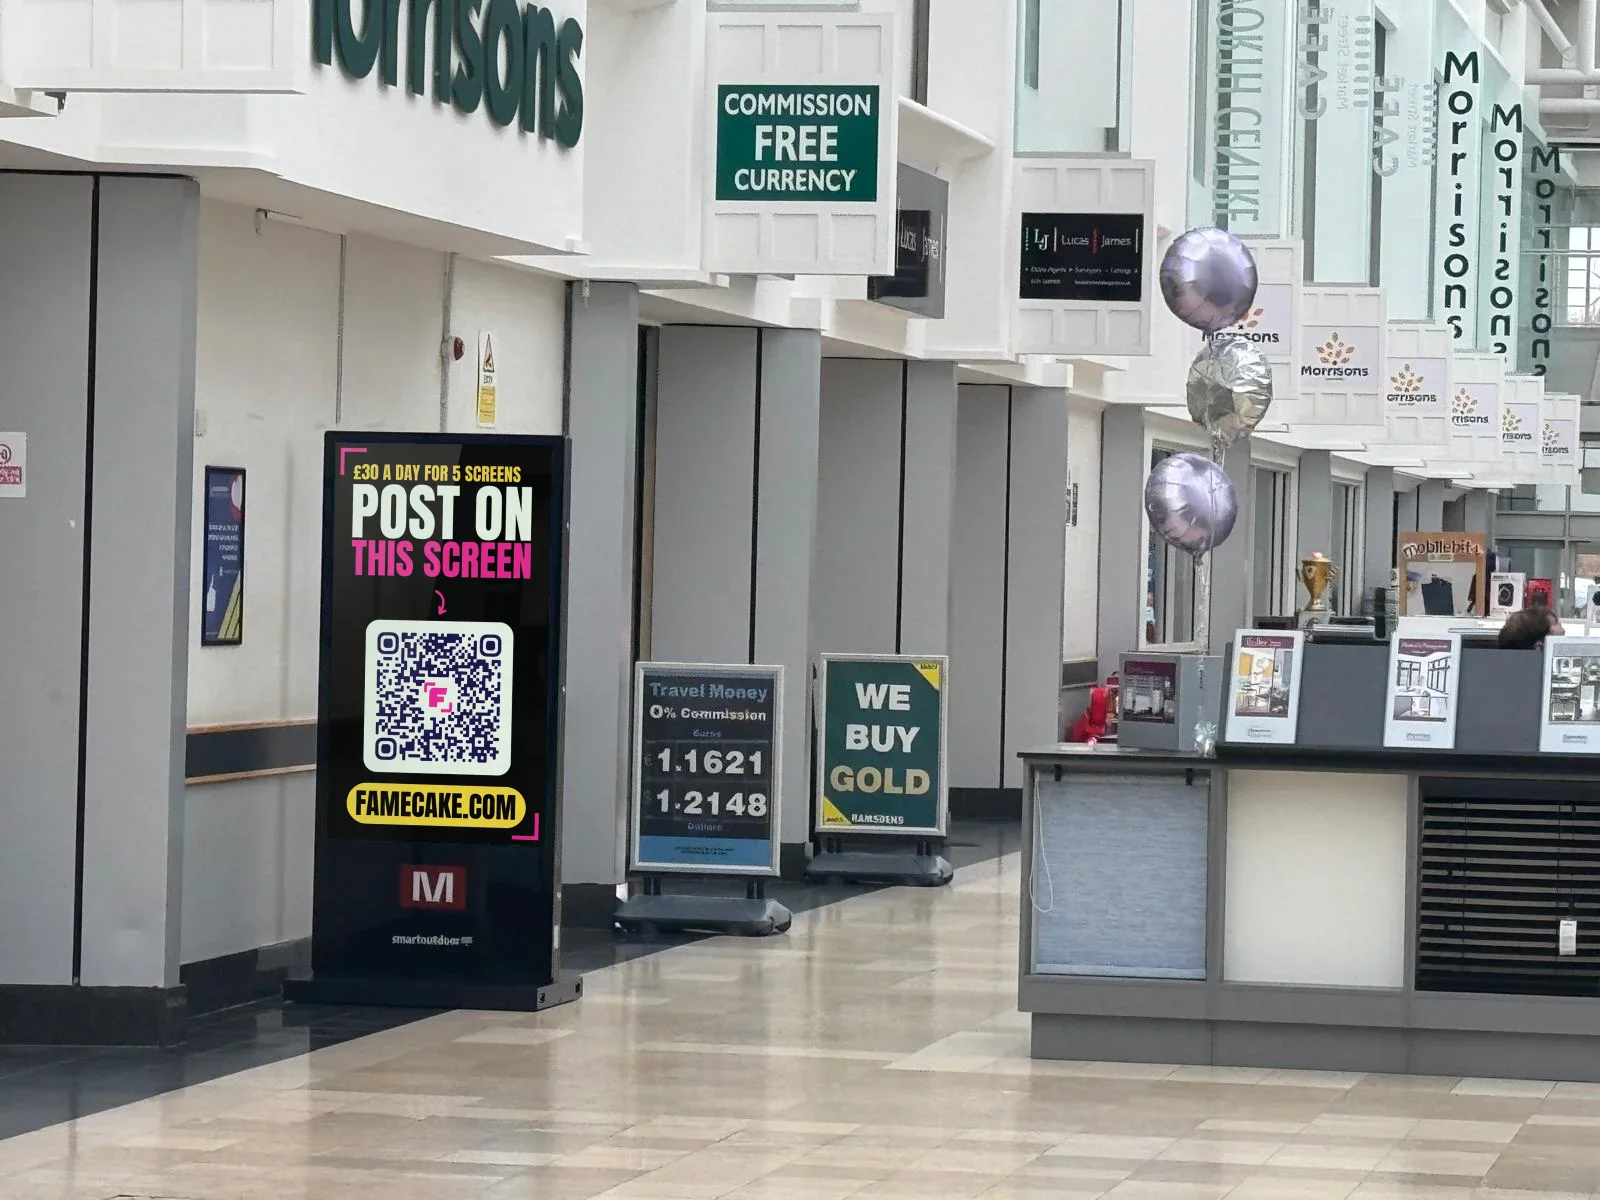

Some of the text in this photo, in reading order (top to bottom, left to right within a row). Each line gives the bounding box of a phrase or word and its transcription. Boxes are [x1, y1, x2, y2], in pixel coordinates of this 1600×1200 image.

[311, 0, 584, 148] orrisons
[724, 93, 871, 116] COMMISSION
[754, 125, 839, 162] FREE
[734, 168, 857, 192] CURRENCY
[1443, 50, 1479, 339] Morrisons
[1061, 234, 1089, 245] Lucas
[1101, 234, 1131, 248] James
[1300, 366, 1369, 377] Morrisons
[1387, 394, 1437, 403] orrisons
[353, 464, 521, 483] £30 A DAY FOR 5 SCREENS
[352, 483, 532, 541] POST ON
[352, 540, 532, 579] THIS SCREEN
[649, 682, 768, 703] Travel Money
[855, 682, 911, 711] WE
[649, 704, 766, 721] 0% Commission
[845, 724, 921, 753] BUY
[657, 747, 762, 775] 1.1621
[830, 765, 931, 795] GOLD
[355, 789, 516, 821] FAMECAKE.COM
[656, 788, 767, 817] 1.2148
[412, 870, 454, 904] M
[391, 934, 461, 946] smartoutdoor
